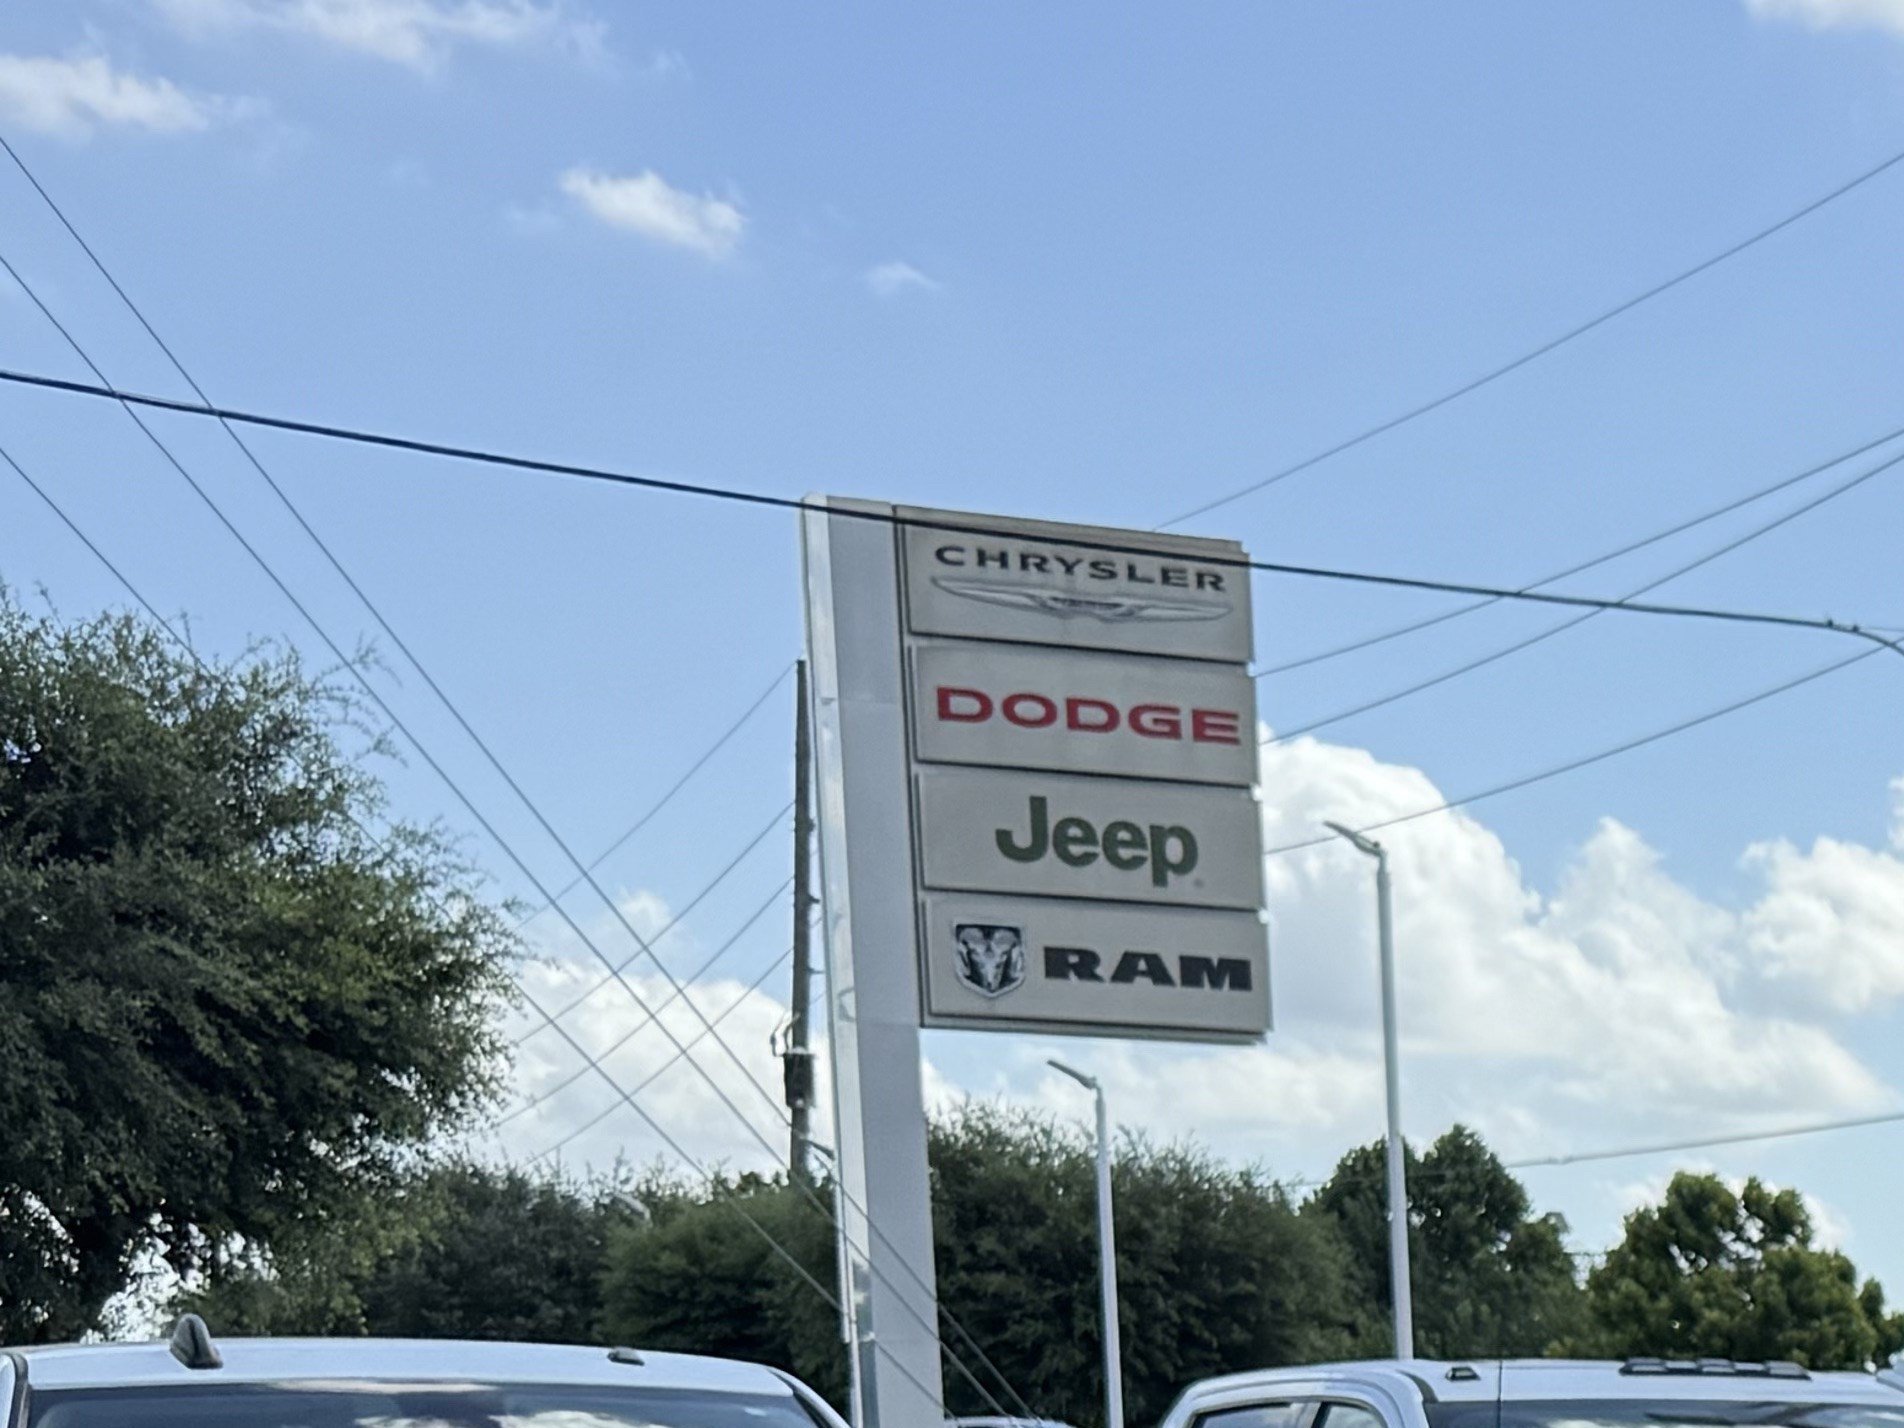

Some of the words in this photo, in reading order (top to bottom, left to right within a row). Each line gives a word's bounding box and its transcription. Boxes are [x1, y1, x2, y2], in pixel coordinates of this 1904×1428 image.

[935, 545, 1227, 592] CHRYSLER
[936, 686, 1241, 746] DODGE
[995, 796, 1198, 888] Jeep
[1044, 946, 1254, 992] RAM
